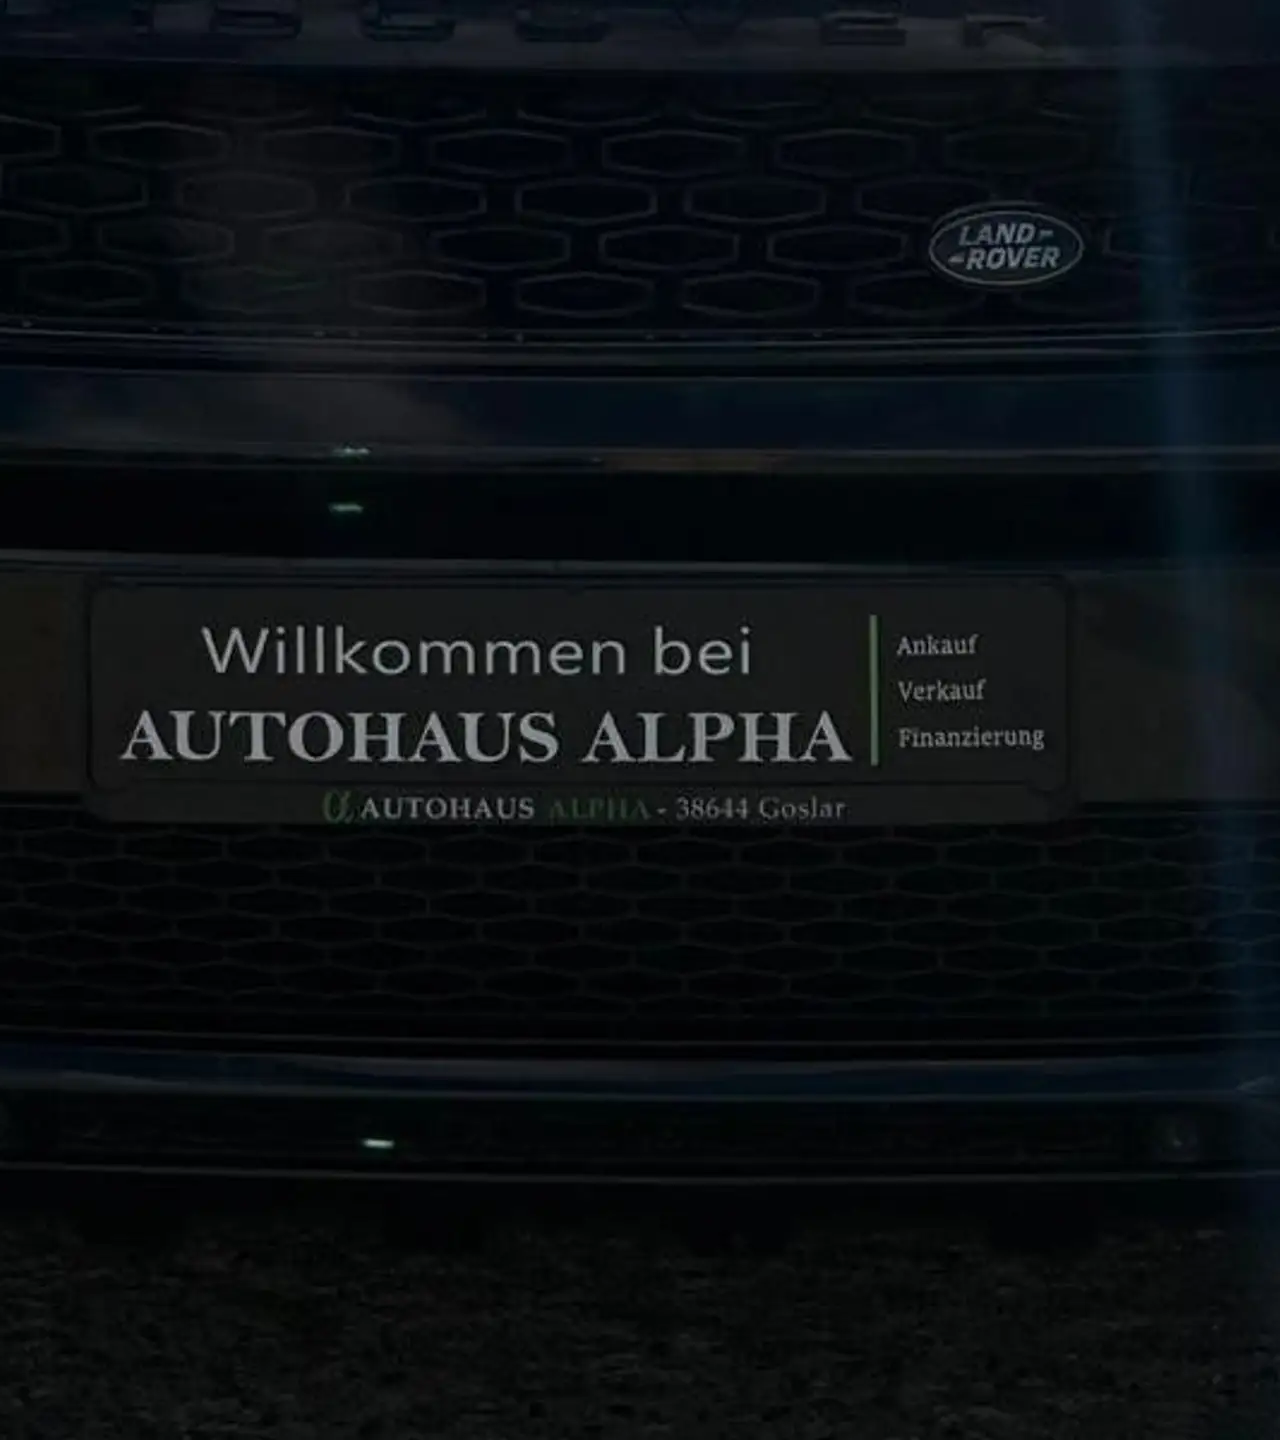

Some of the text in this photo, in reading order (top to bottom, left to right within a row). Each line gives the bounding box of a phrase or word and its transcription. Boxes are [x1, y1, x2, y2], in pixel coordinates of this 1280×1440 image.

[200, 623, 752, 676] Willkommen bei
[896, 633, 980, 657] Ankauf
[897, 679, 988, 702] Verkauf
[119, 709, 854, 765] AUTOHAUS ALPHA
[897, 725, 1046, 751] Finanzierung
[360, 796, 535, 821] AUTOHAUS
[547, 798, 653, 821] ALPHA
[675, 796, 749, 821] 38644
[758, 796, 848, 821] Goslar
